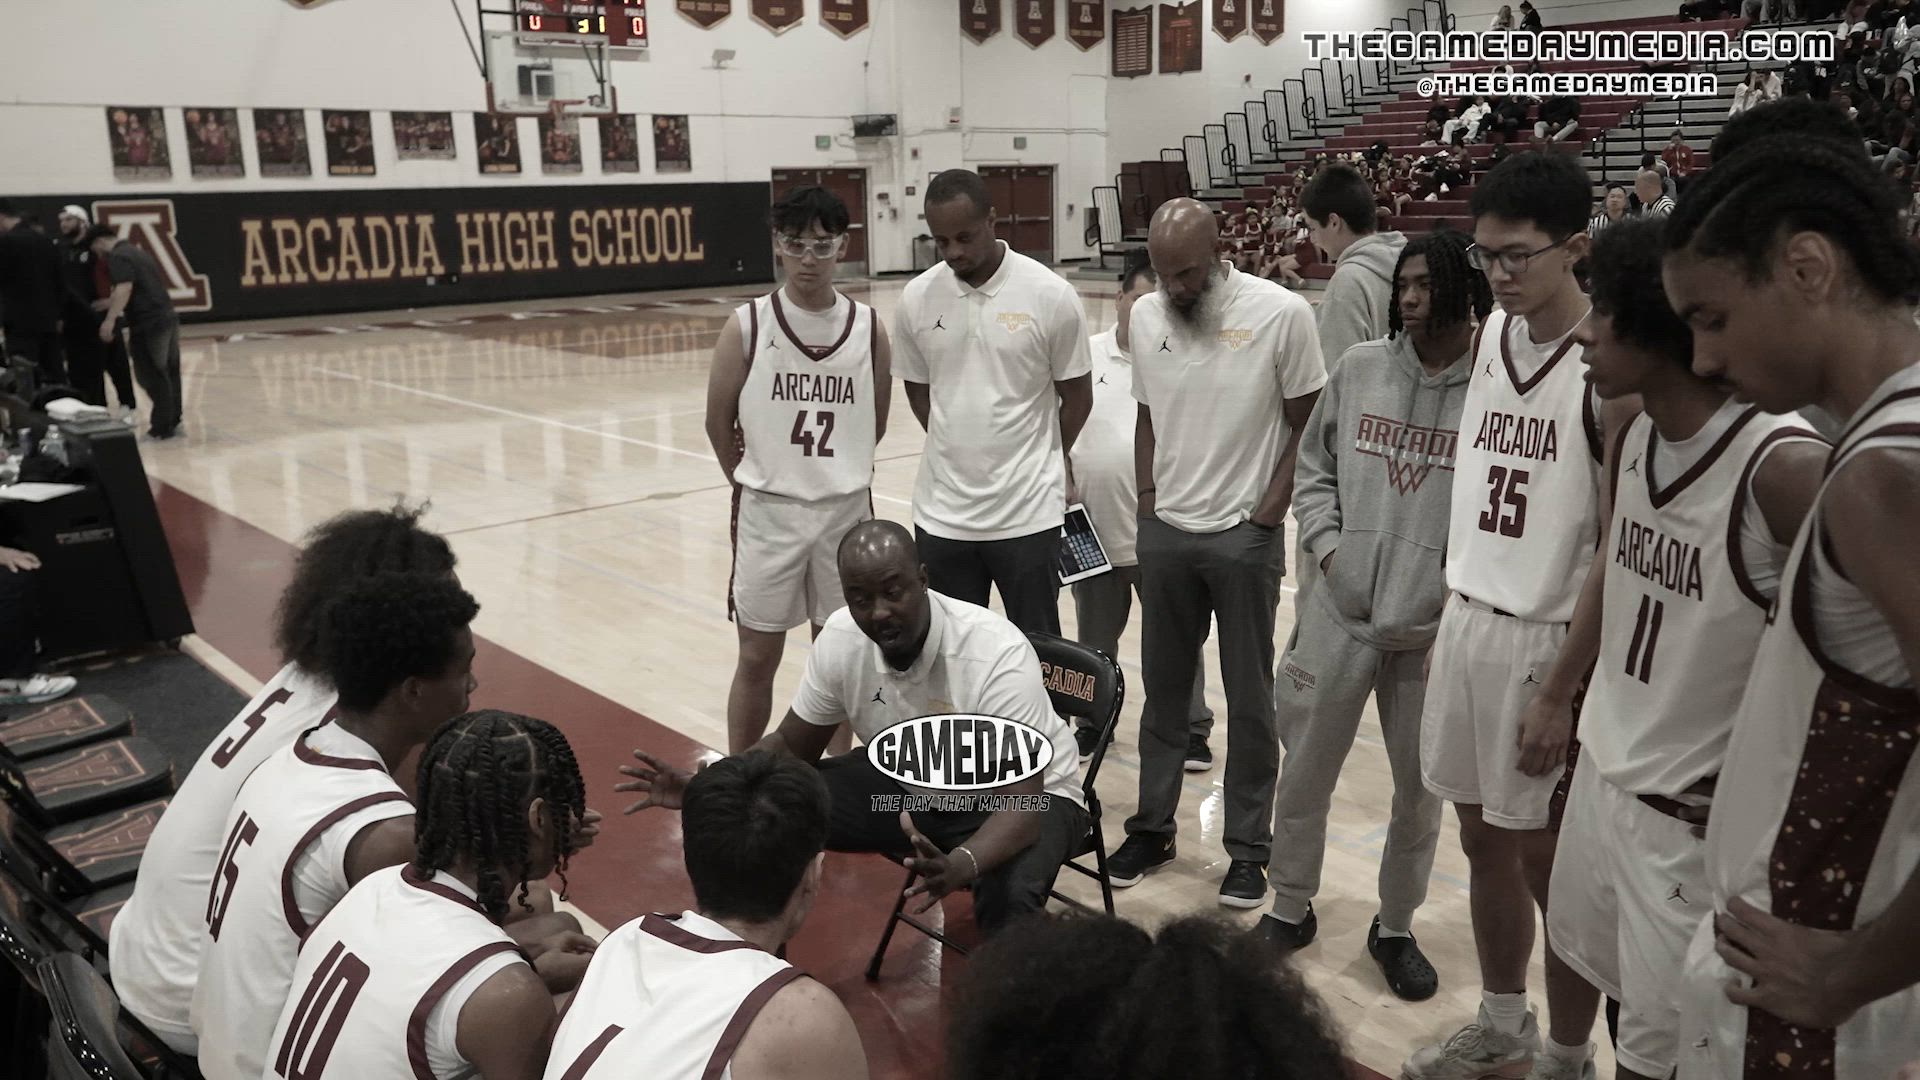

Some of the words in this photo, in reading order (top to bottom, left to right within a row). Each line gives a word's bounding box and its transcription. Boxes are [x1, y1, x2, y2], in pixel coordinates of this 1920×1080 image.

[241, 214, 445, 287] ARCADIA
[456, 207, 558, 273] HIGH
[570, 206, 704, 267] SCHOOL
[771, 372, 855, 404] ARCADIA
[790, 410, 835, 457] 42
[1357, 418, 1458, 458] ARCADI
[1473, 410, 1557, 462] ARCADIA
[1478, 465, 1529, 539] 35
[1616, 517, 1703, 602] ARCADIA
[1625, 594, 1664, 684] 11
[1040, 661, 1095, 702] CADIA
[211, 688, 294, 769] 5
[205, 810, 260, 943] 15
[274, 940, 370, 1080] 10
